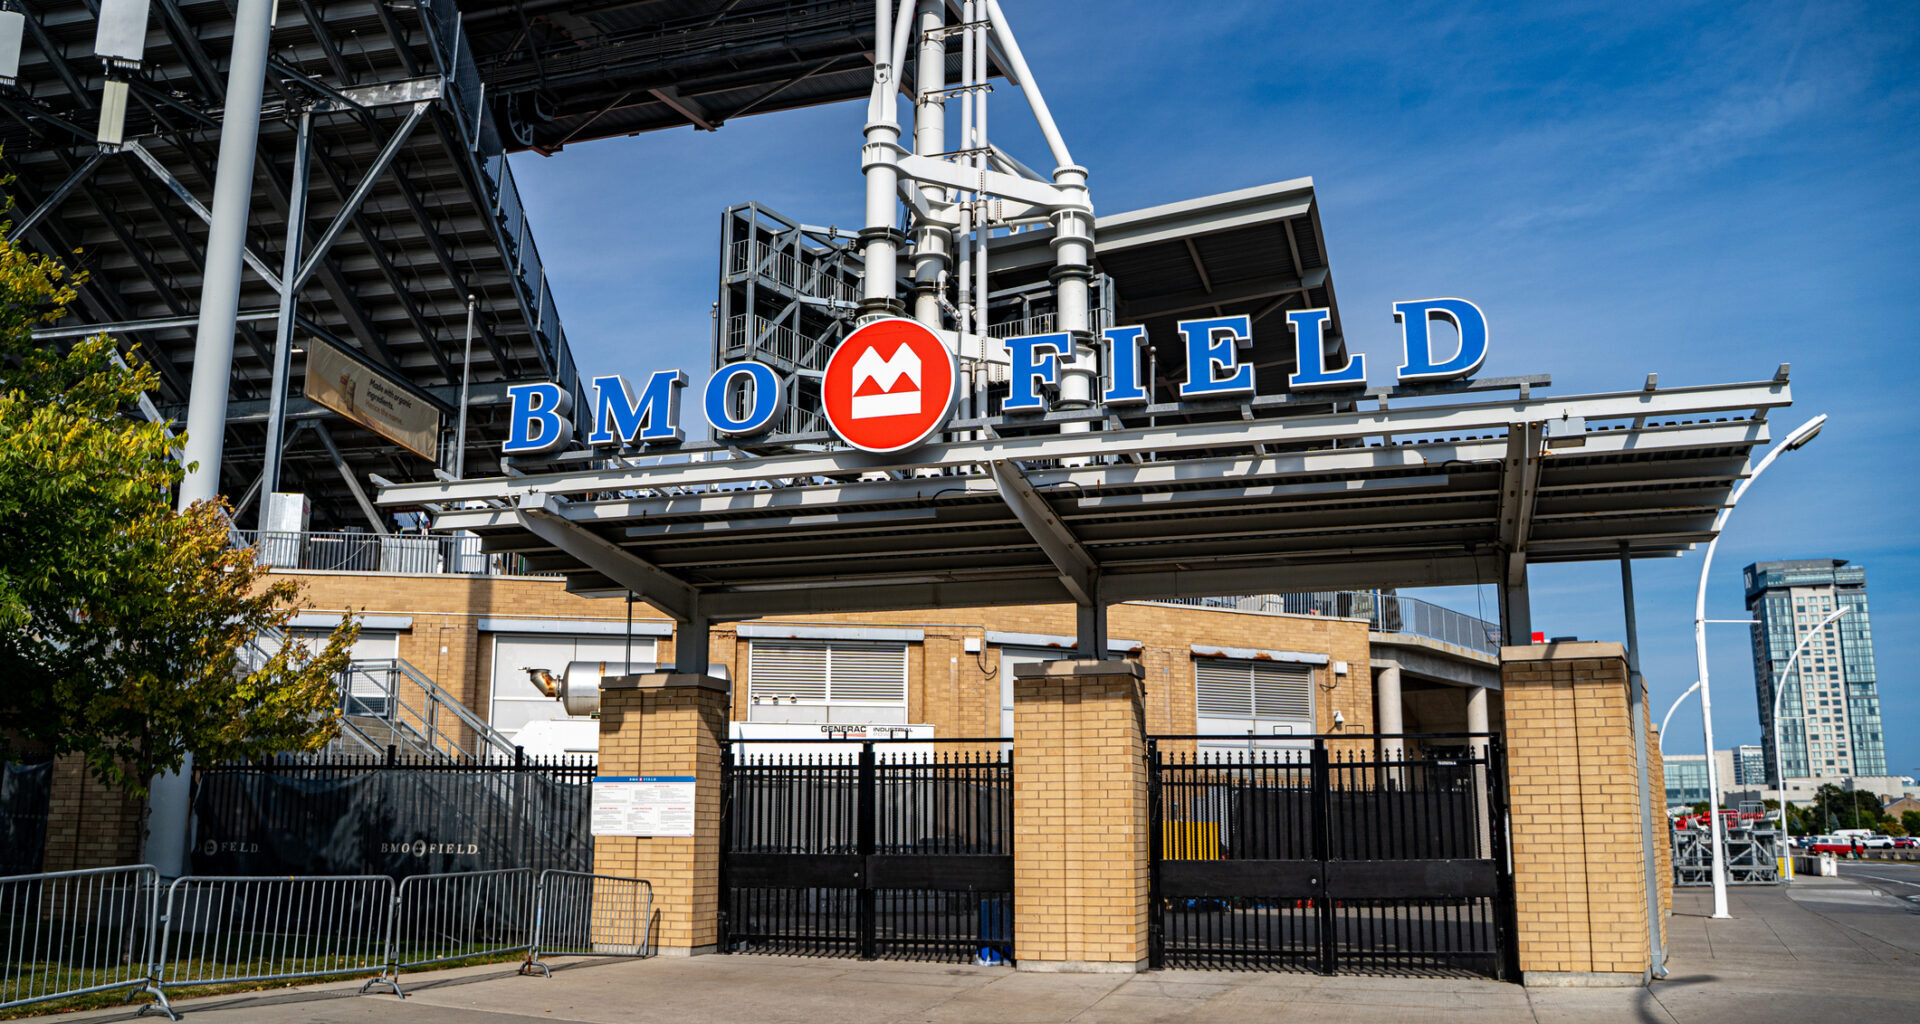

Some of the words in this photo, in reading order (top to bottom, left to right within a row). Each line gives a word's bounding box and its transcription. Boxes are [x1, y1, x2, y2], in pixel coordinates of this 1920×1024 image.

[502, 361, 786, 454] BMO
[1001, 297, 1488, 413] FIELD
[370, 379, 383, 392] Made
[384, 388, 394, 398] with
[394, 395, 412, 408] organic
[381, 843, 410, 853] BMO
